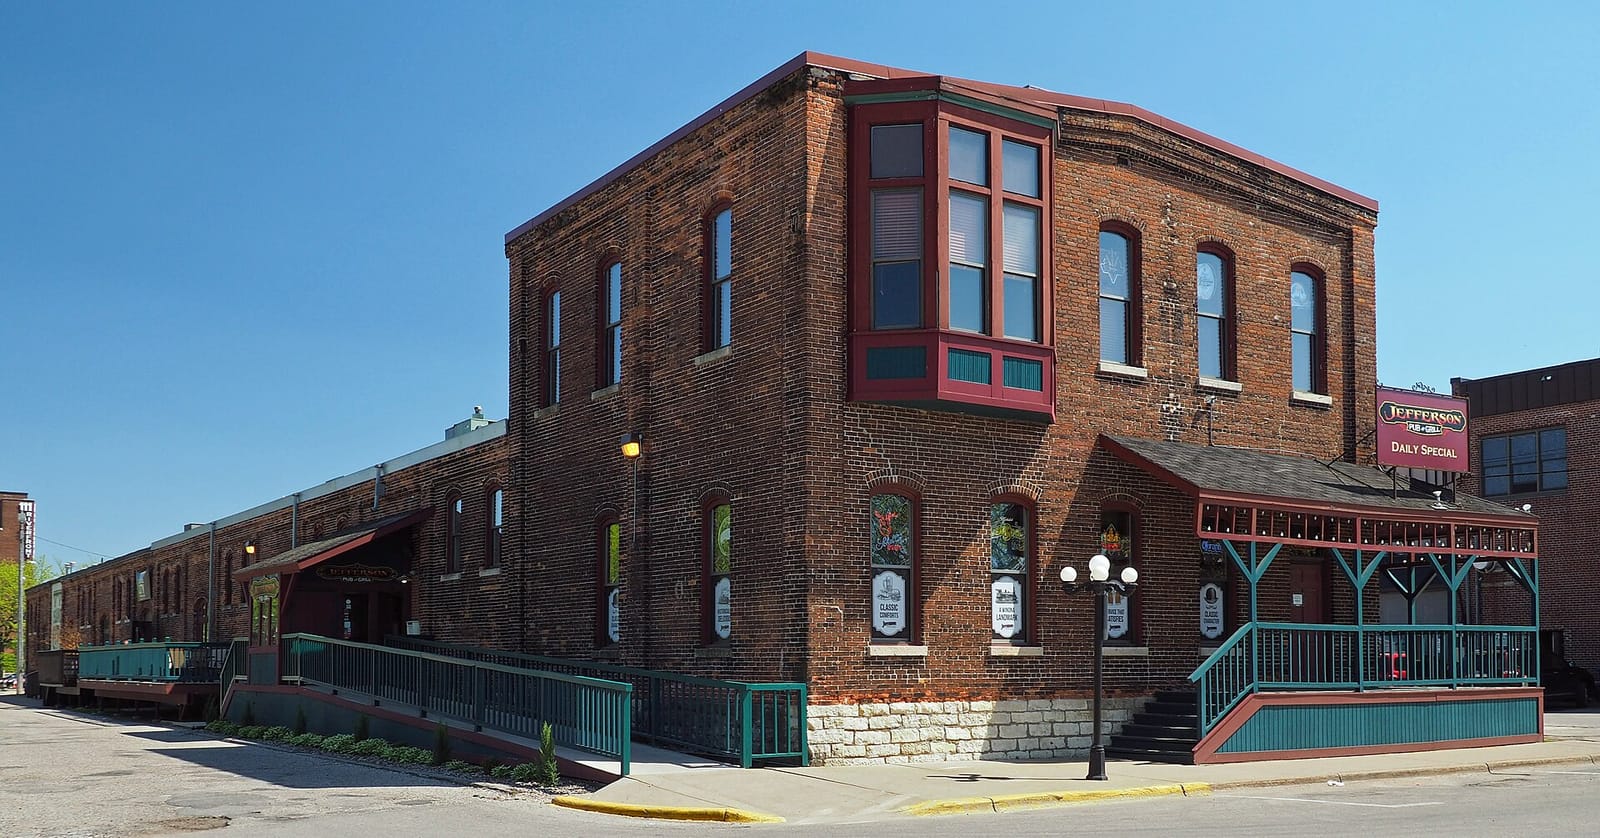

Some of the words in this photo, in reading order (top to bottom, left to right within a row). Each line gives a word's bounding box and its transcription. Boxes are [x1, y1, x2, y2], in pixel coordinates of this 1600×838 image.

[1384, 405, 1462, 425] JEFFERSON
[1408, 423, 1421, 432] PUB
[1425, 425, 1441, 433] GRILL
[1391, 441, 1419, 454] DAILY
[1421, 445, 1458, 458] SPECIAL
[879, 603, 899, 611] CLASSIC
[995, 613, 1018, 621] LANDMARK
